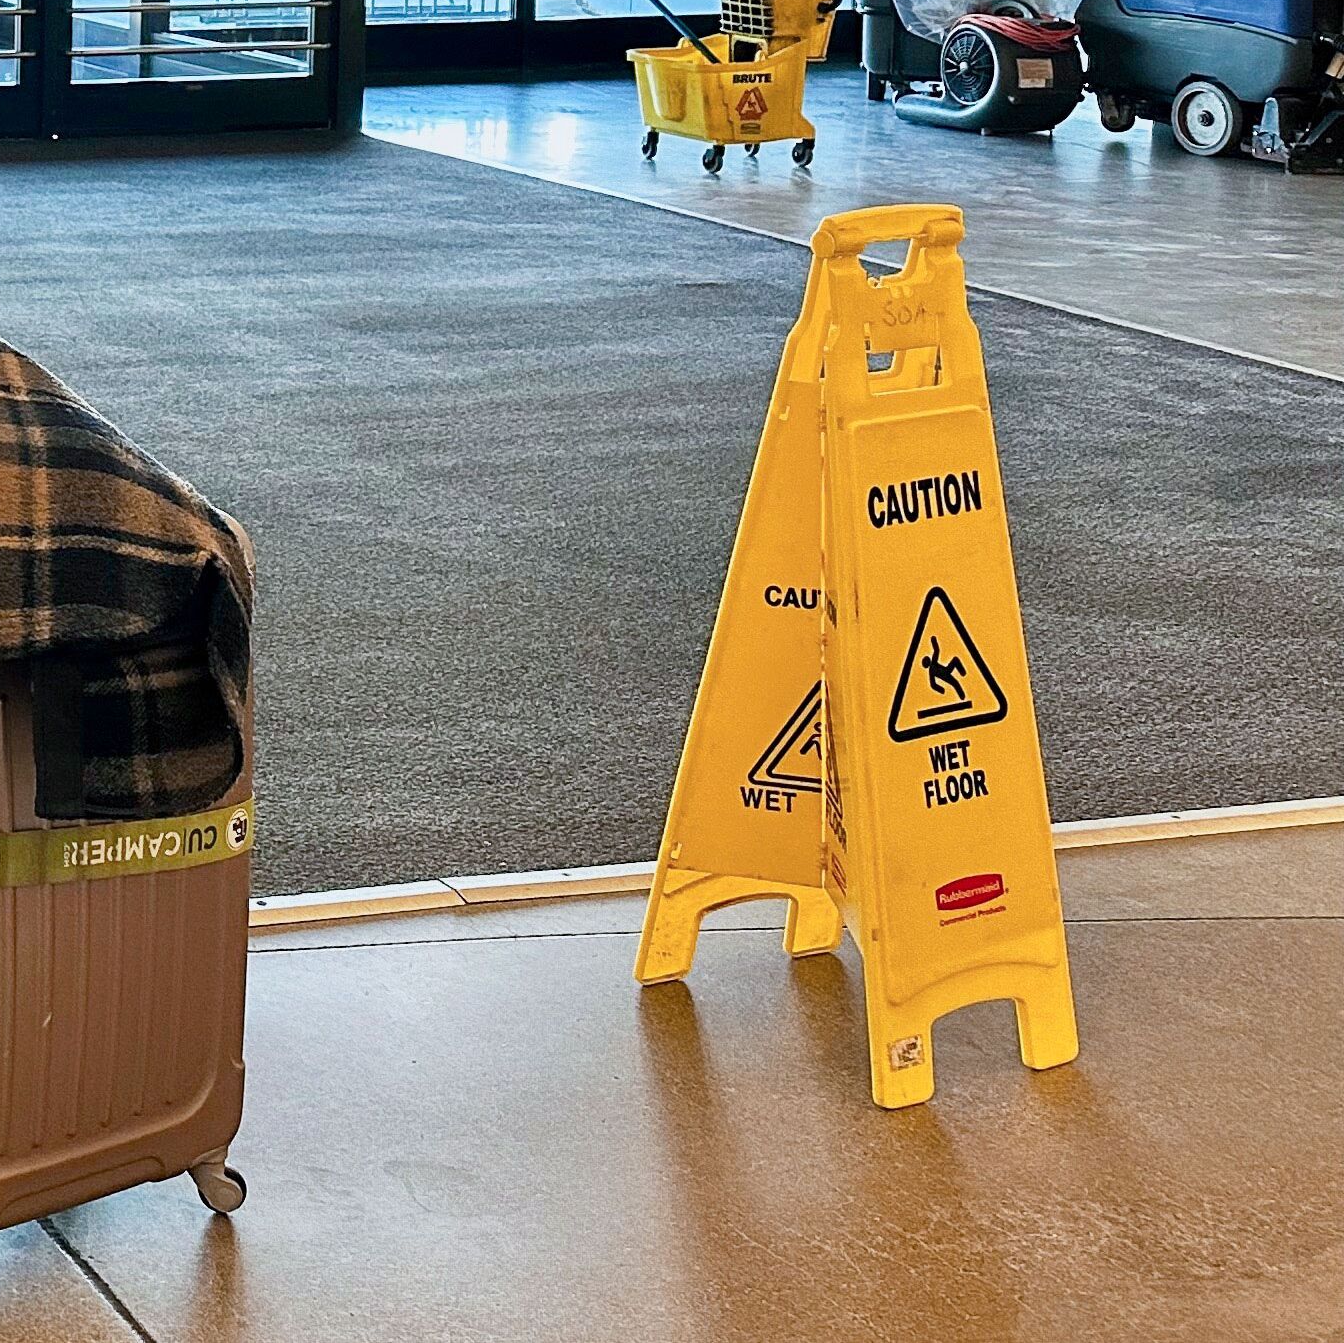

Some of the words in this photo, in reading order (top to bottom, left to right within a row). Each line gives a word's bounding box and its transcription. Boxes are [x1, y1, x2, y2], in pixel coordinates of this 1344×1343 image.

[732, 72, 772, 84] BRUTE
[867, 470, 982, 529] CAUTION
[928, 739, 971, 774] WET
[739, 786, 797, 813] WET
[923, 769, 989, 809] FLOOR
[938, 879, 1001, 905] Rubbermaid
